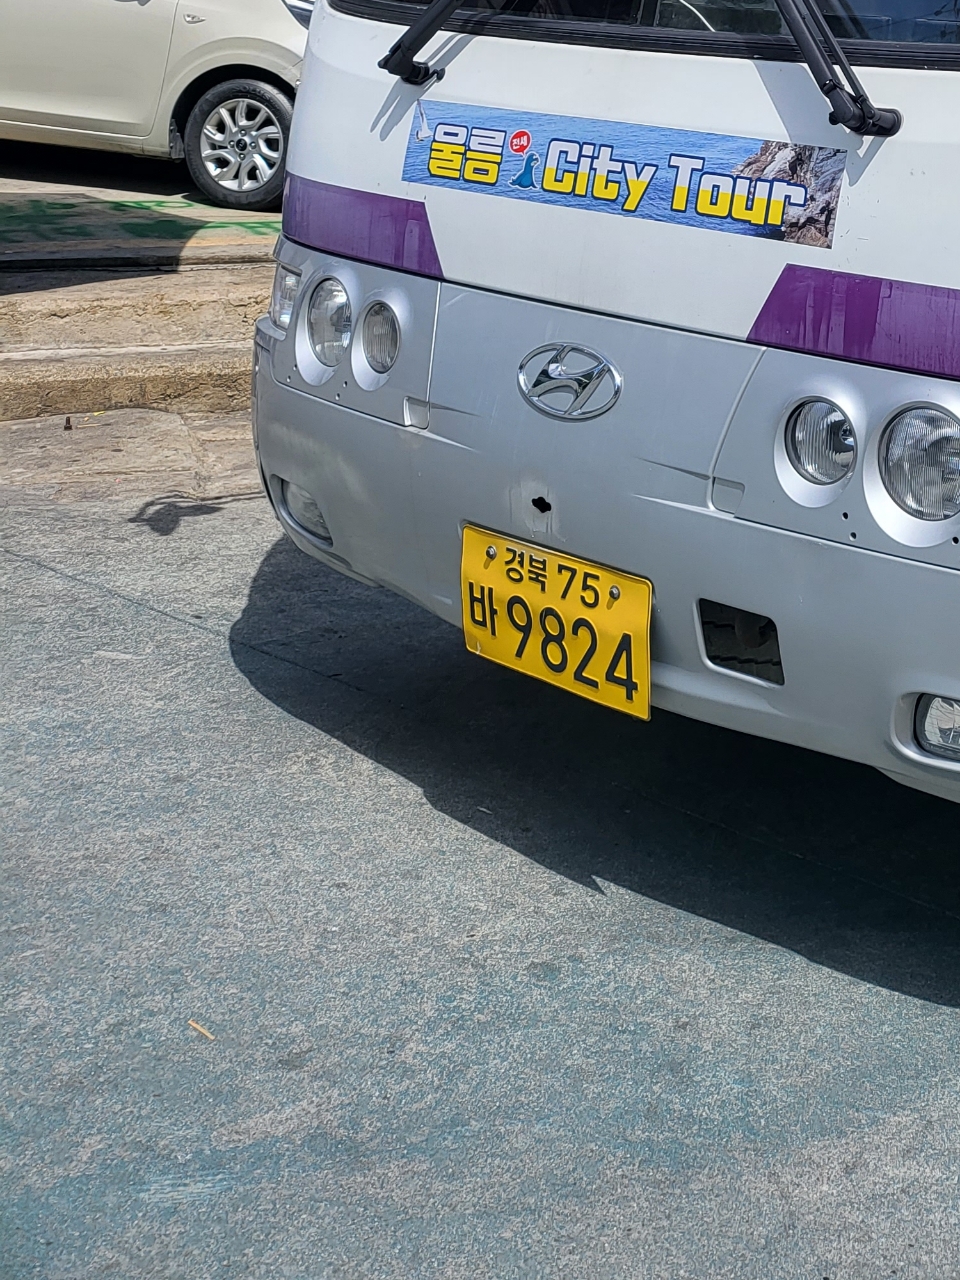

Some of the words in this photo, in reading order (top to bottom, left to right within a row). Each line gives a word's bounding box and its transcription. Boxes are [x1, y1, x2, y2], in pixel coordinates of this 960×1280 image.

[428, 122, 507, 186] 울릉
[541, 139, 659, 212] City
[668, 152, 808, 226] Tour
[557, 563, 600, 608] 75
